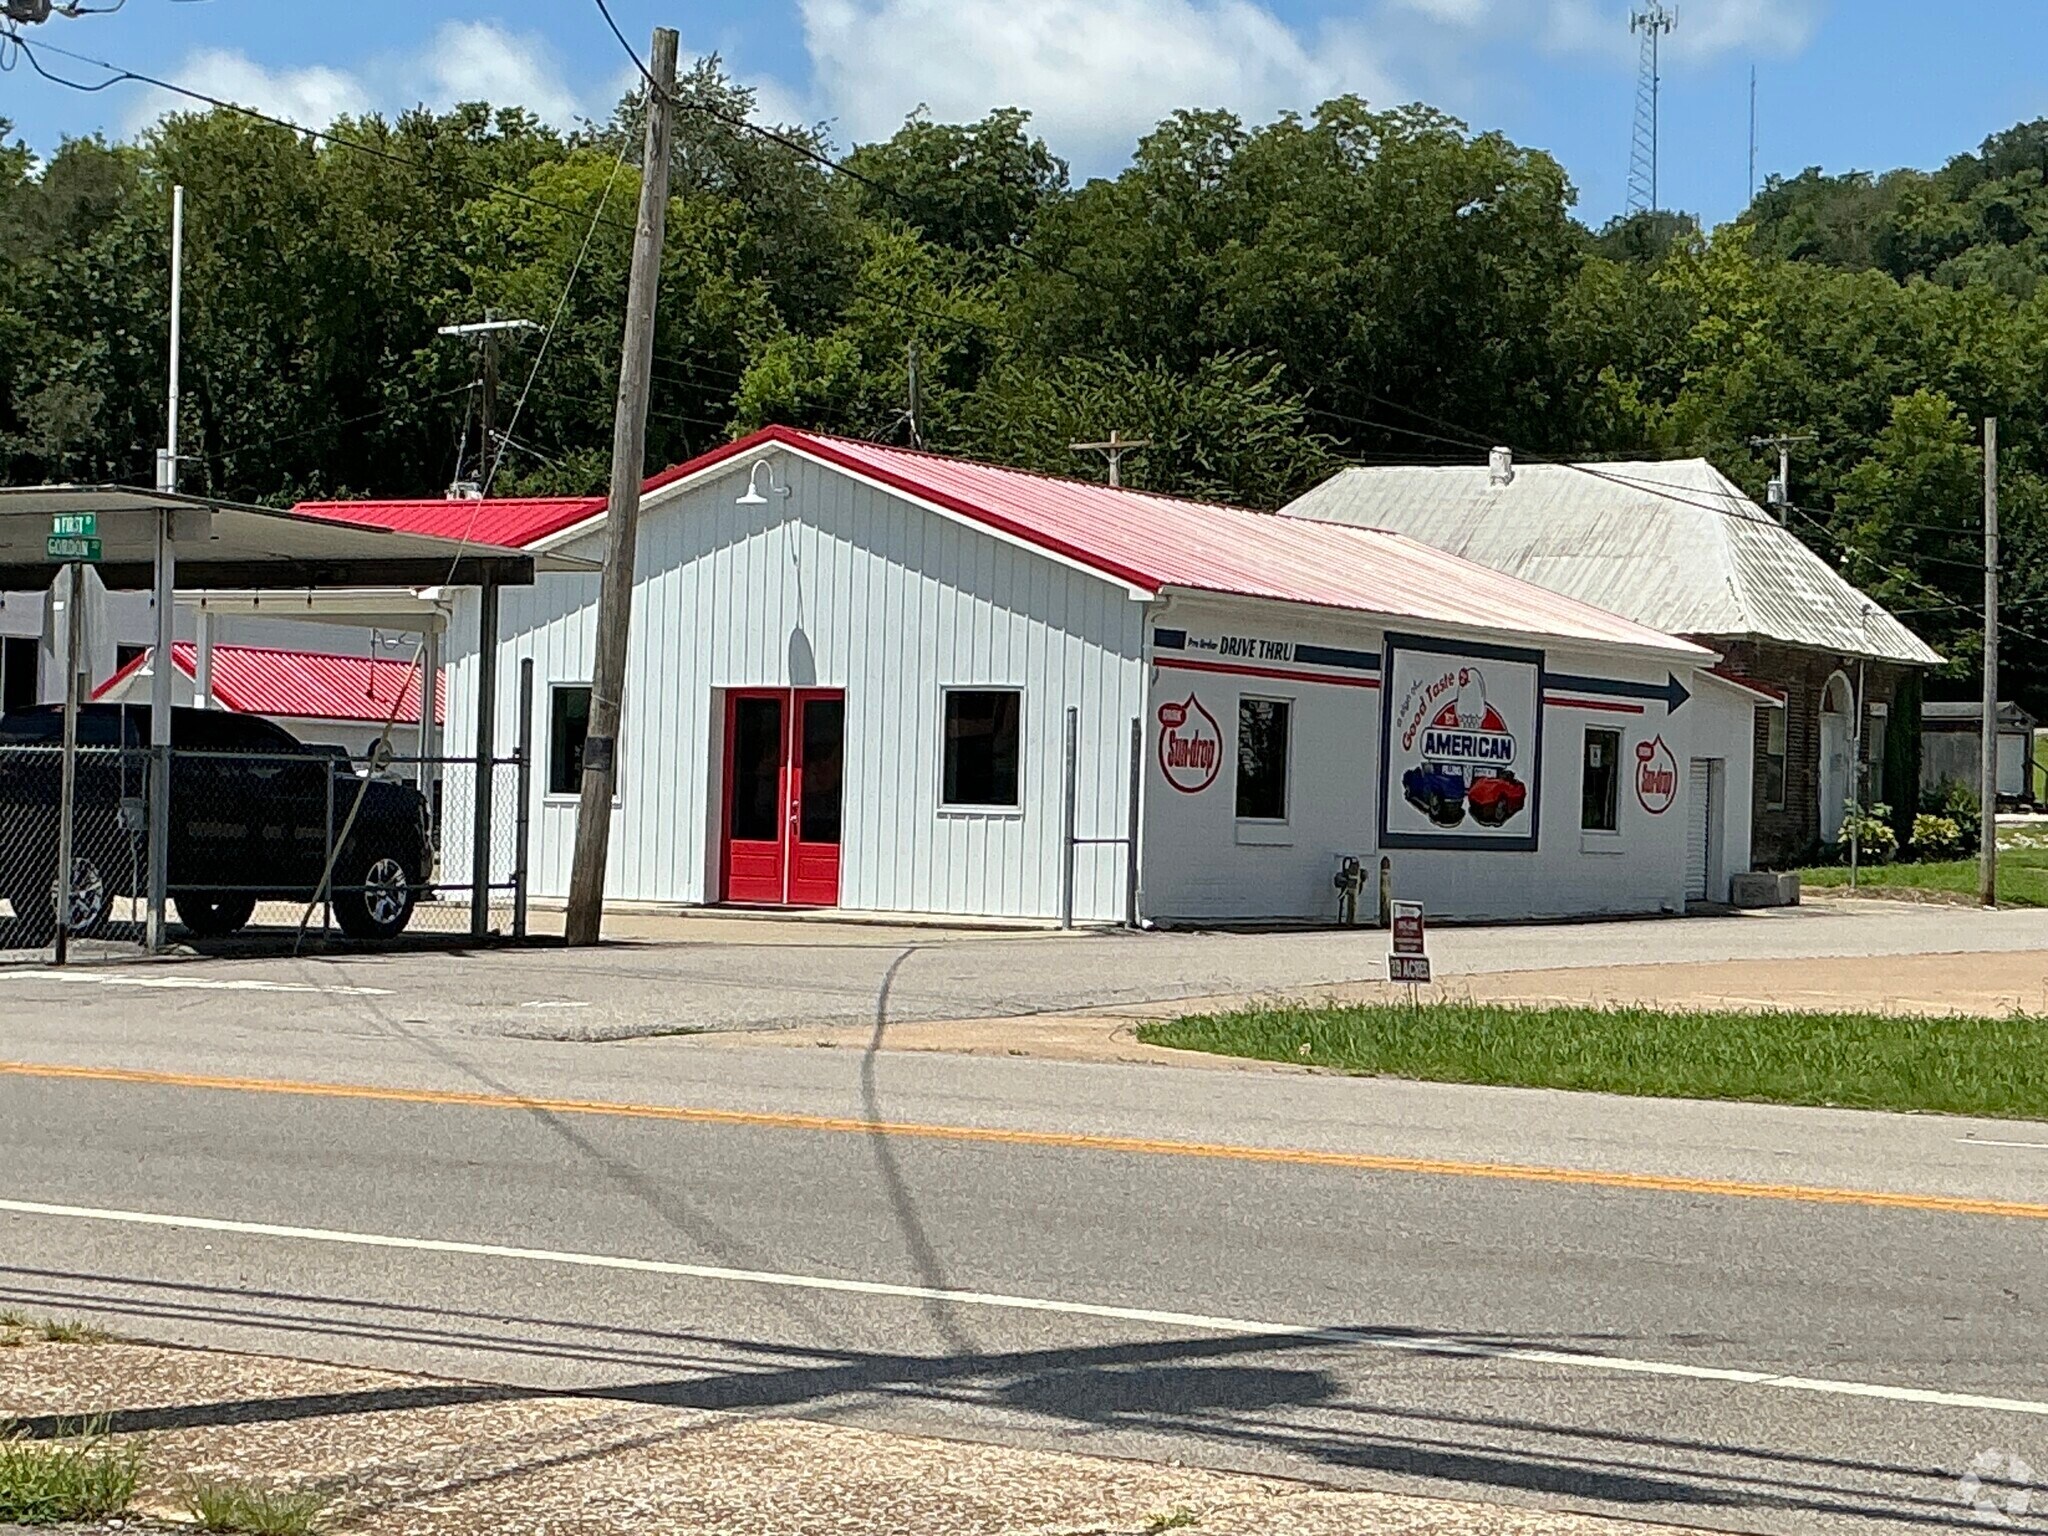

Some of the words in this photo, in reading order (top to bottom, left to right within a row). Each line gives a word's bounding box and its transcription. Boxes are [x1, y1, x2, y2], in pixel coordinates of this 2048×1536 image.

[61, 516, 84, 534] FIRST
[1219, 636, 1256, 657] DRIVE
[1259, 640, 1293, 661] THRU
[1402, 695, 1427, 752] Good
[1425, 672, 1455, 704] Taste
[1424, 732, 1512, 761] AMERICAN
